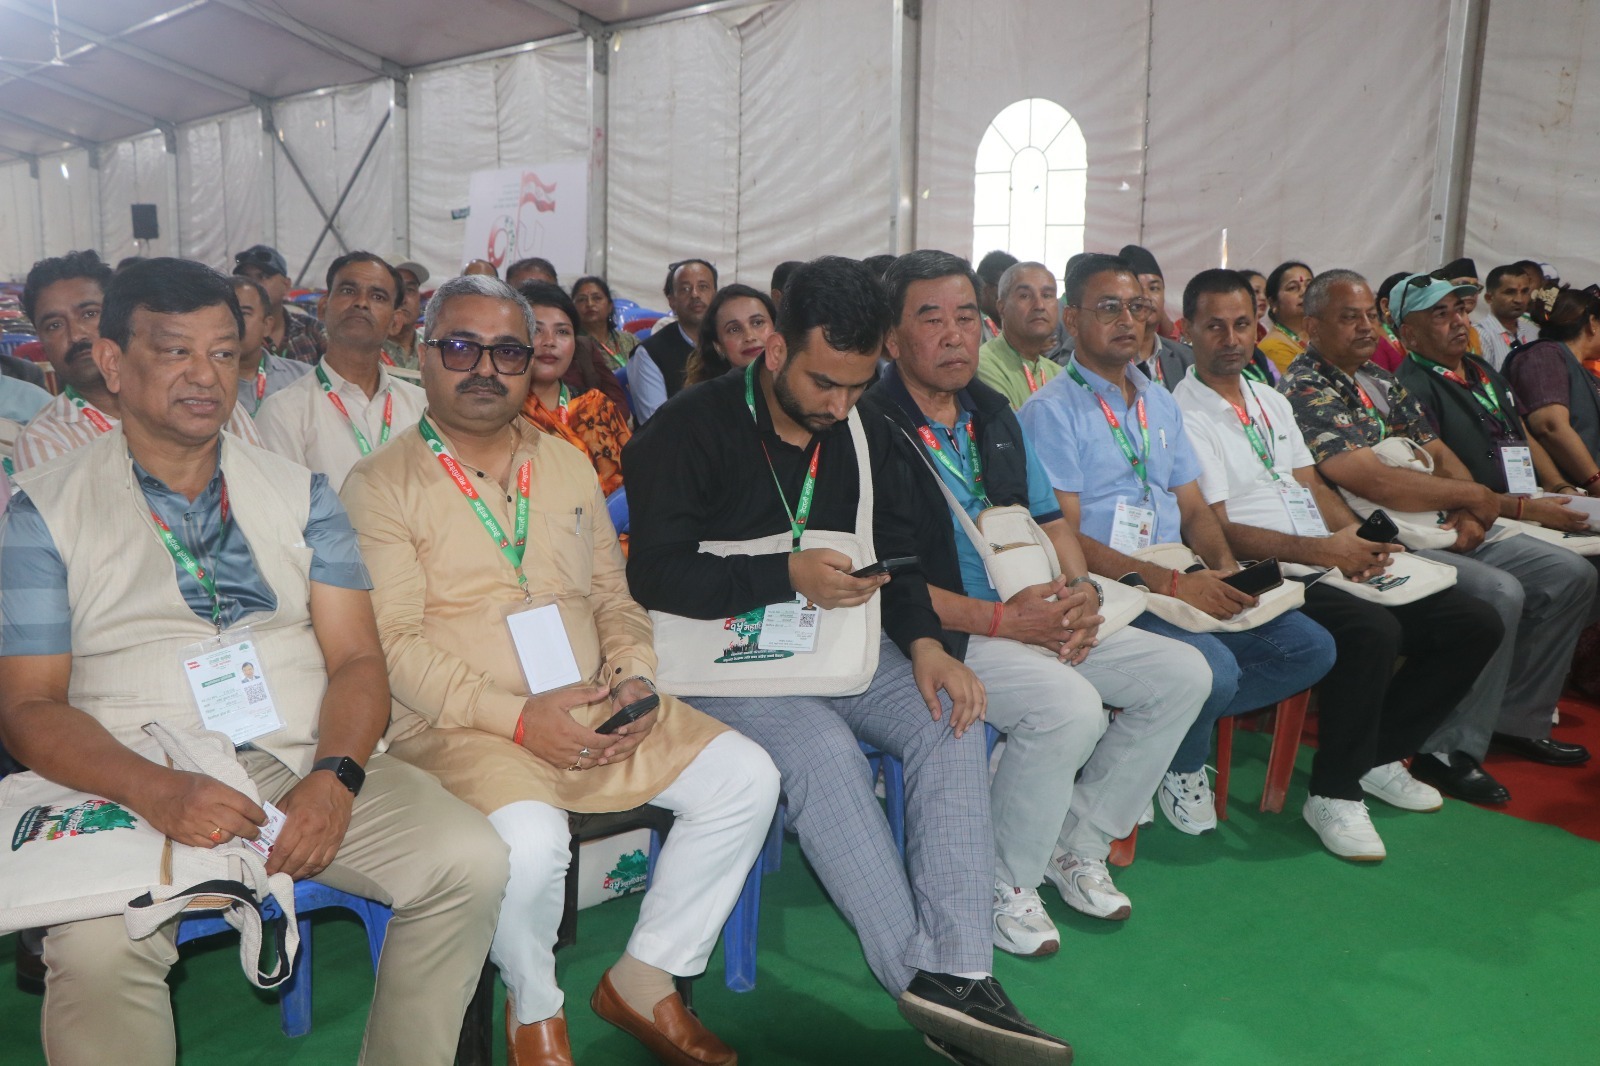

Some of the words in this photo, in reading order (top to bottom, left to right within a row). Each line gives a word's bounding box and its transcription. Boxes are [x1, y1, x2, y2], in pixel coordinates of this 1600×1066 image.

[443, 457, 466, 486] महाधिवेशन
[485, 519, 501, 538] नेपाली
[177, 549, 195, 568] नेपाली
